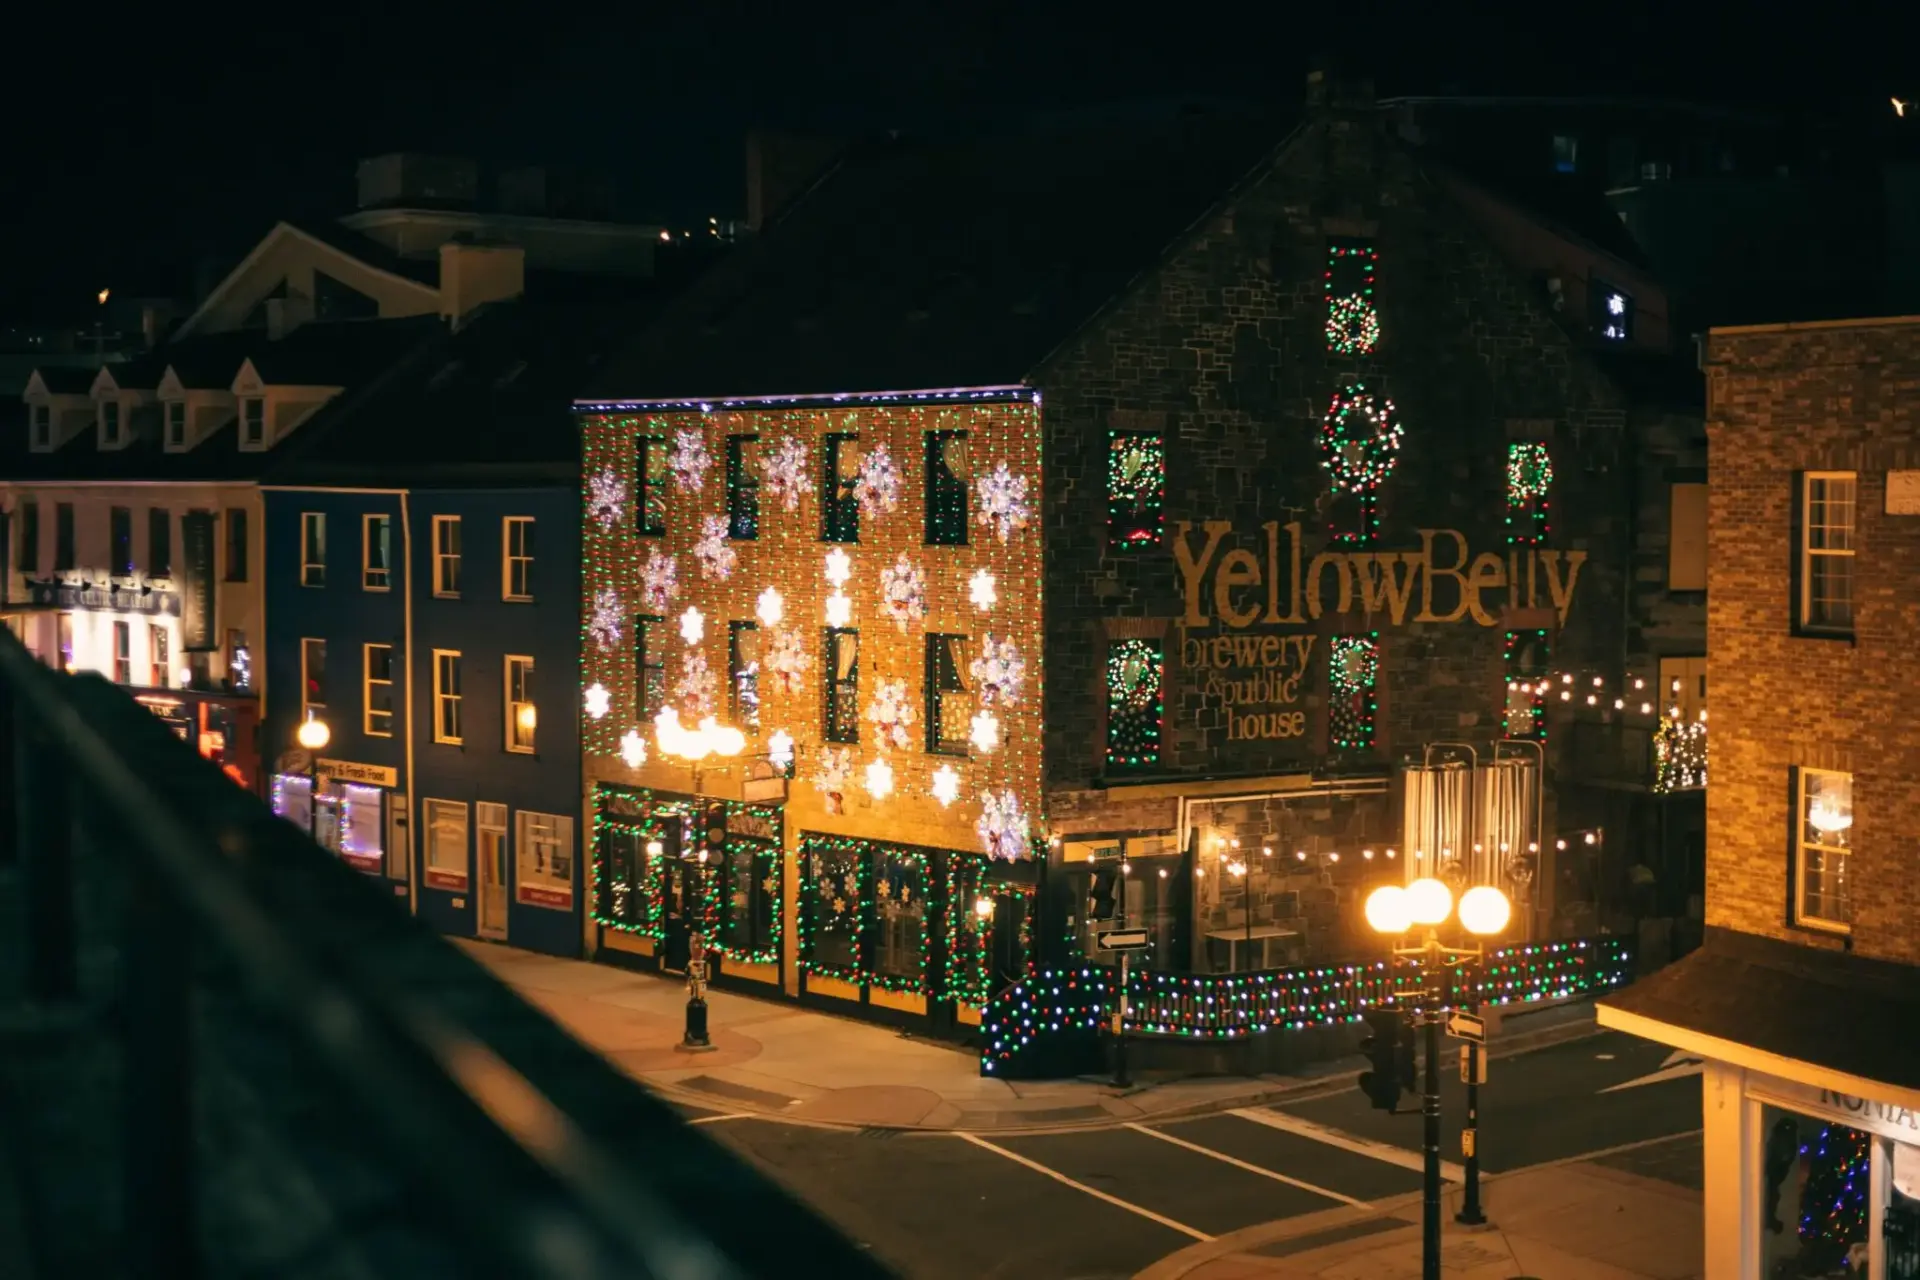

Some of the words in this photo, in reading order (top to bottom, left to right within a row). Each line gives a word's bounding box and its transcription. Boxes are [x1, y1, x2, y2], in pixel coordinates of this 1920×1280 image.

[1173, 520, 1588, 628] YellowBelly
[1179, 625, 1317, 679] brewery
[1220, 668, 1300, 706] public
[1226, 707, 1306, 741] house
